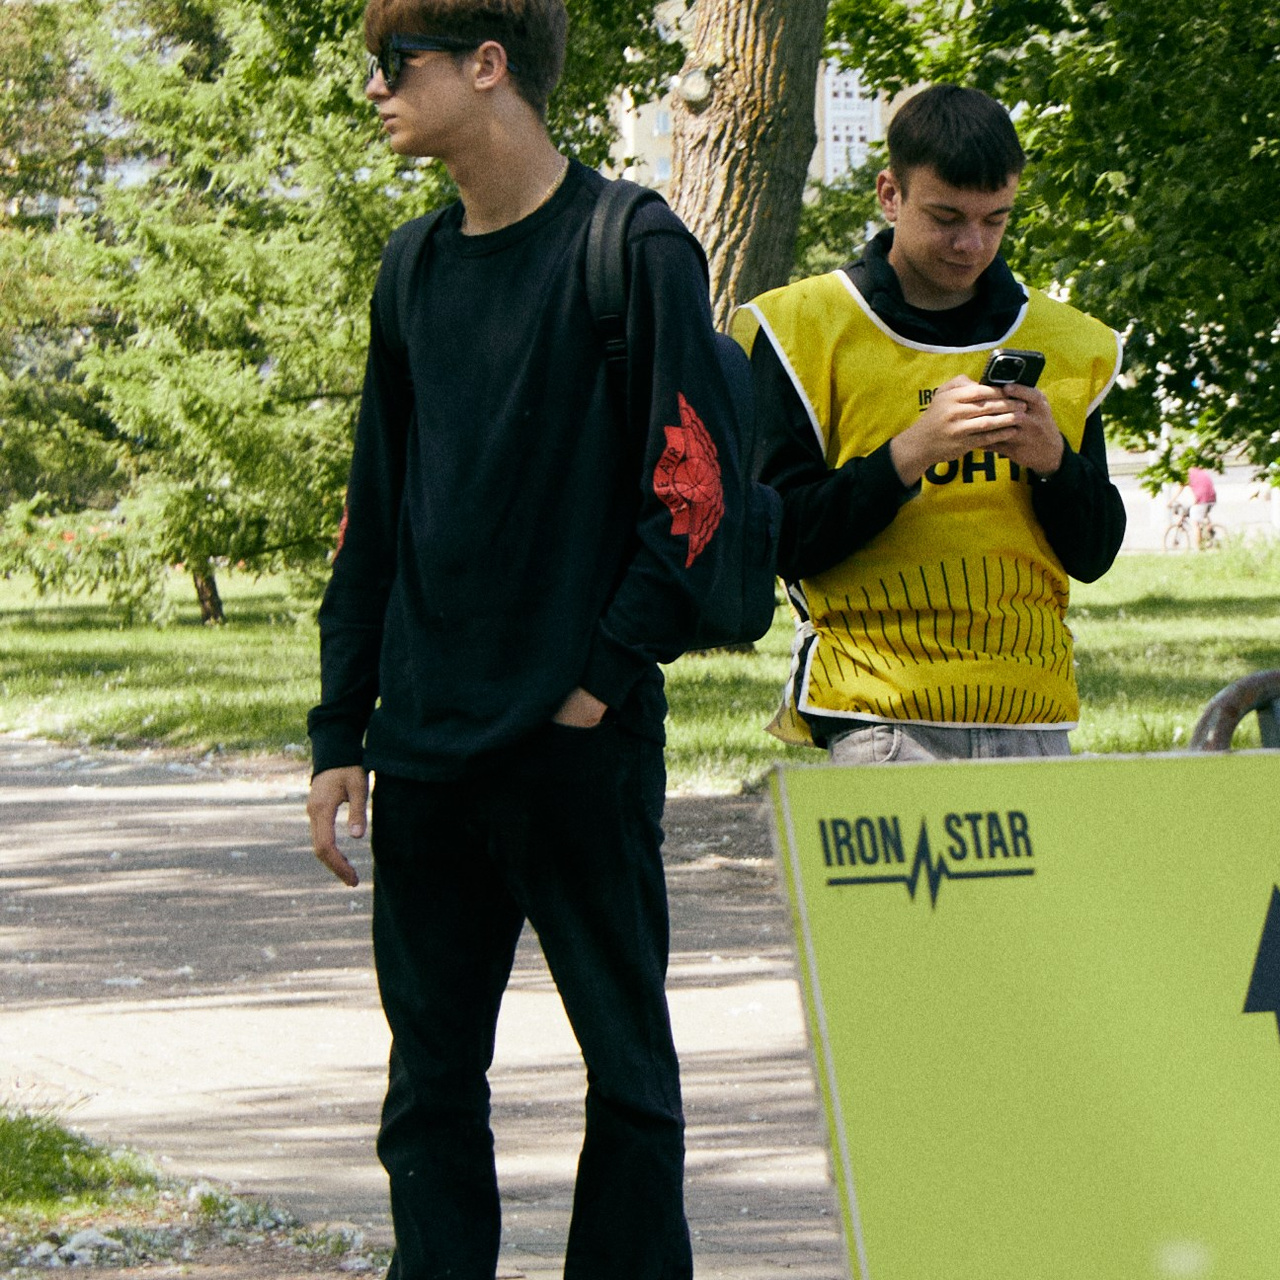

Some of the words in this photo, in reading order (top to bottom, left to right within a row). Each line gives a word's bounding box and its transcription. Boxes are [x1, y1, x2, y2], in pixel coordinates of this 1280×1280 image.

[659, 446, 681, 475] AIR
[818, 816, 905, 867] IRON
[944, 811, 1034, 860] STAR
